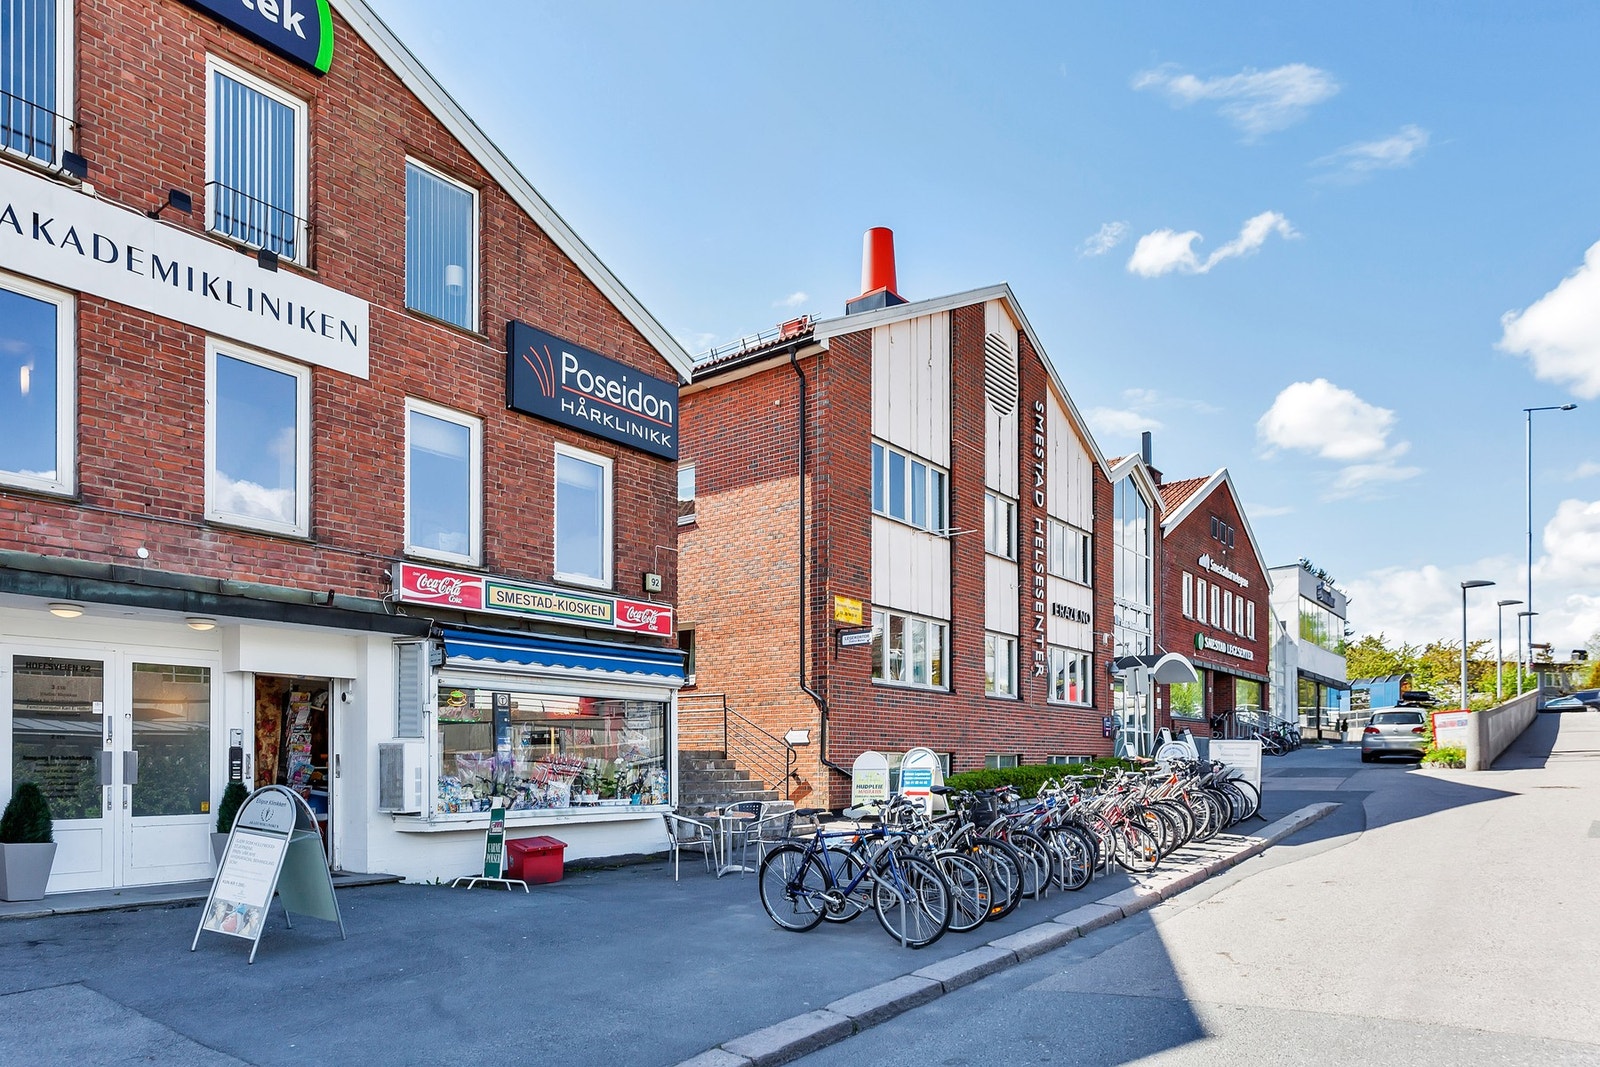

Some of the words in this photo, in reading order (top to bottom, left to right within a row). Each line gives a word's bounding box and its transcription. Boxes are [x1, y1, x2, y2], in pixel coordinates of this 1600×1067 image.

[241, 0, 306, 39] ek
[0, 203, 358, 347] AKADEMIKLINIKEN
[562, 351, 673, 423] Poseidon
[561, 397, 672, 448] HÅRKLINIKK
[1034, 400, 1045, 508] SMESTAD
[416, 571, 463, 596] Coca-Cola
[496, 590, 606, 617] SMESTAD-KIOSKEN
[651, 578, 660, 587] 92
[1034, 517, 1045, 678] HELSESENTER
[25, 661, 79, 672] HOFFSVEIEN
[81, 665, 92, 673] 92
